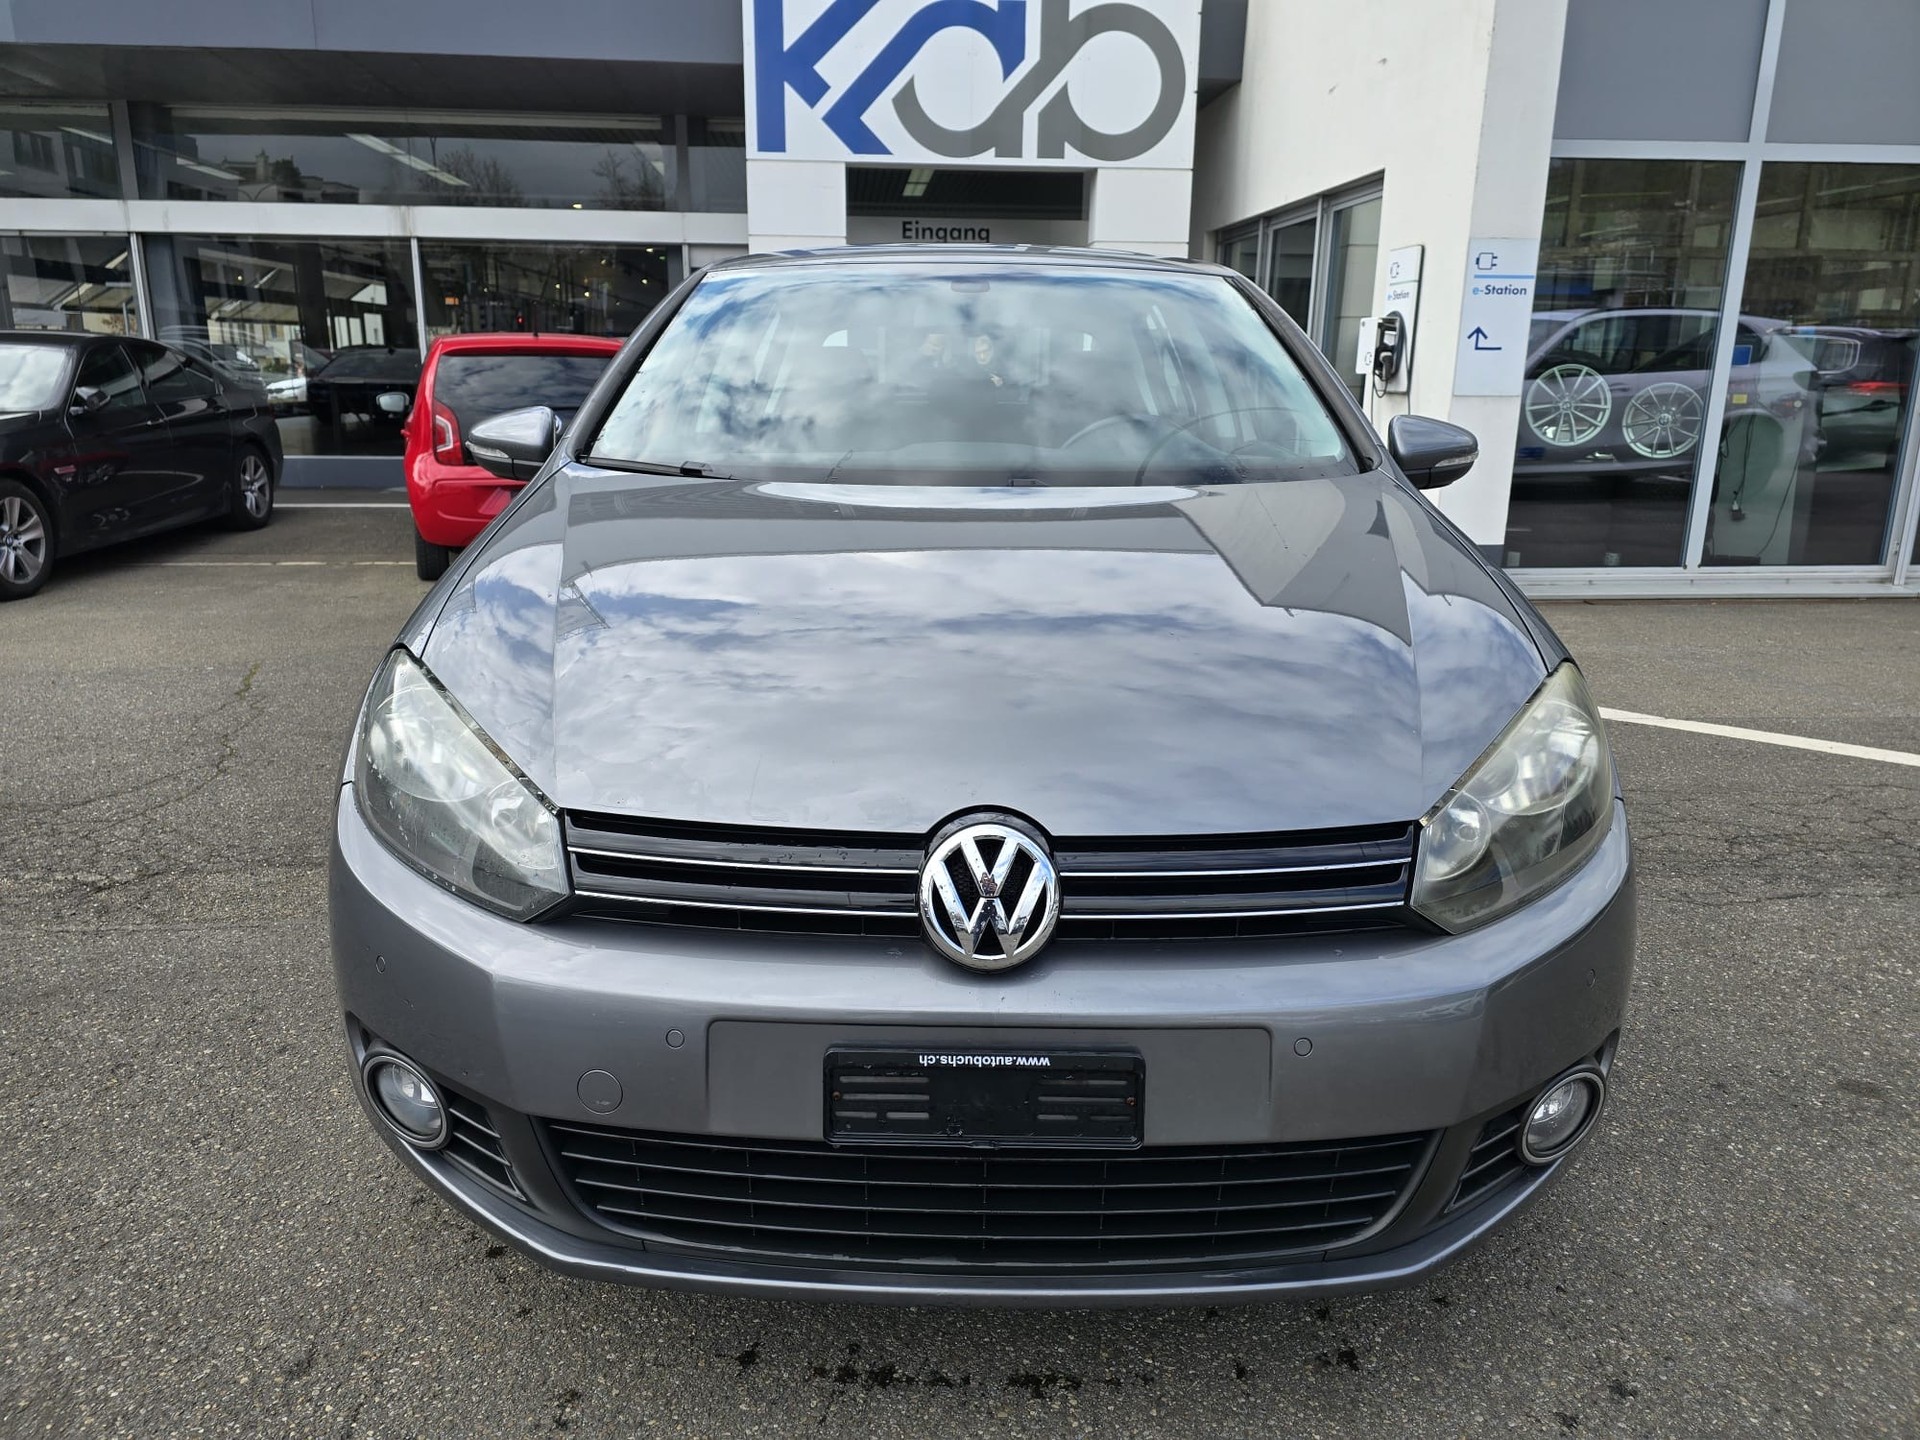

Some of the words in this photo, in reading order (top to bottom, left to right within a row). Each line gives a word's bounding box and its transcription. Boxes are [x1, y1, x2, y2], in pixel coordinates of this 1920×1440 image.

[902, 220, 990, 243] Eingang
[1472, 283, 1528, 296] e-Station
[919, 1055, 1051, 1068] www.autobuchs.ch
